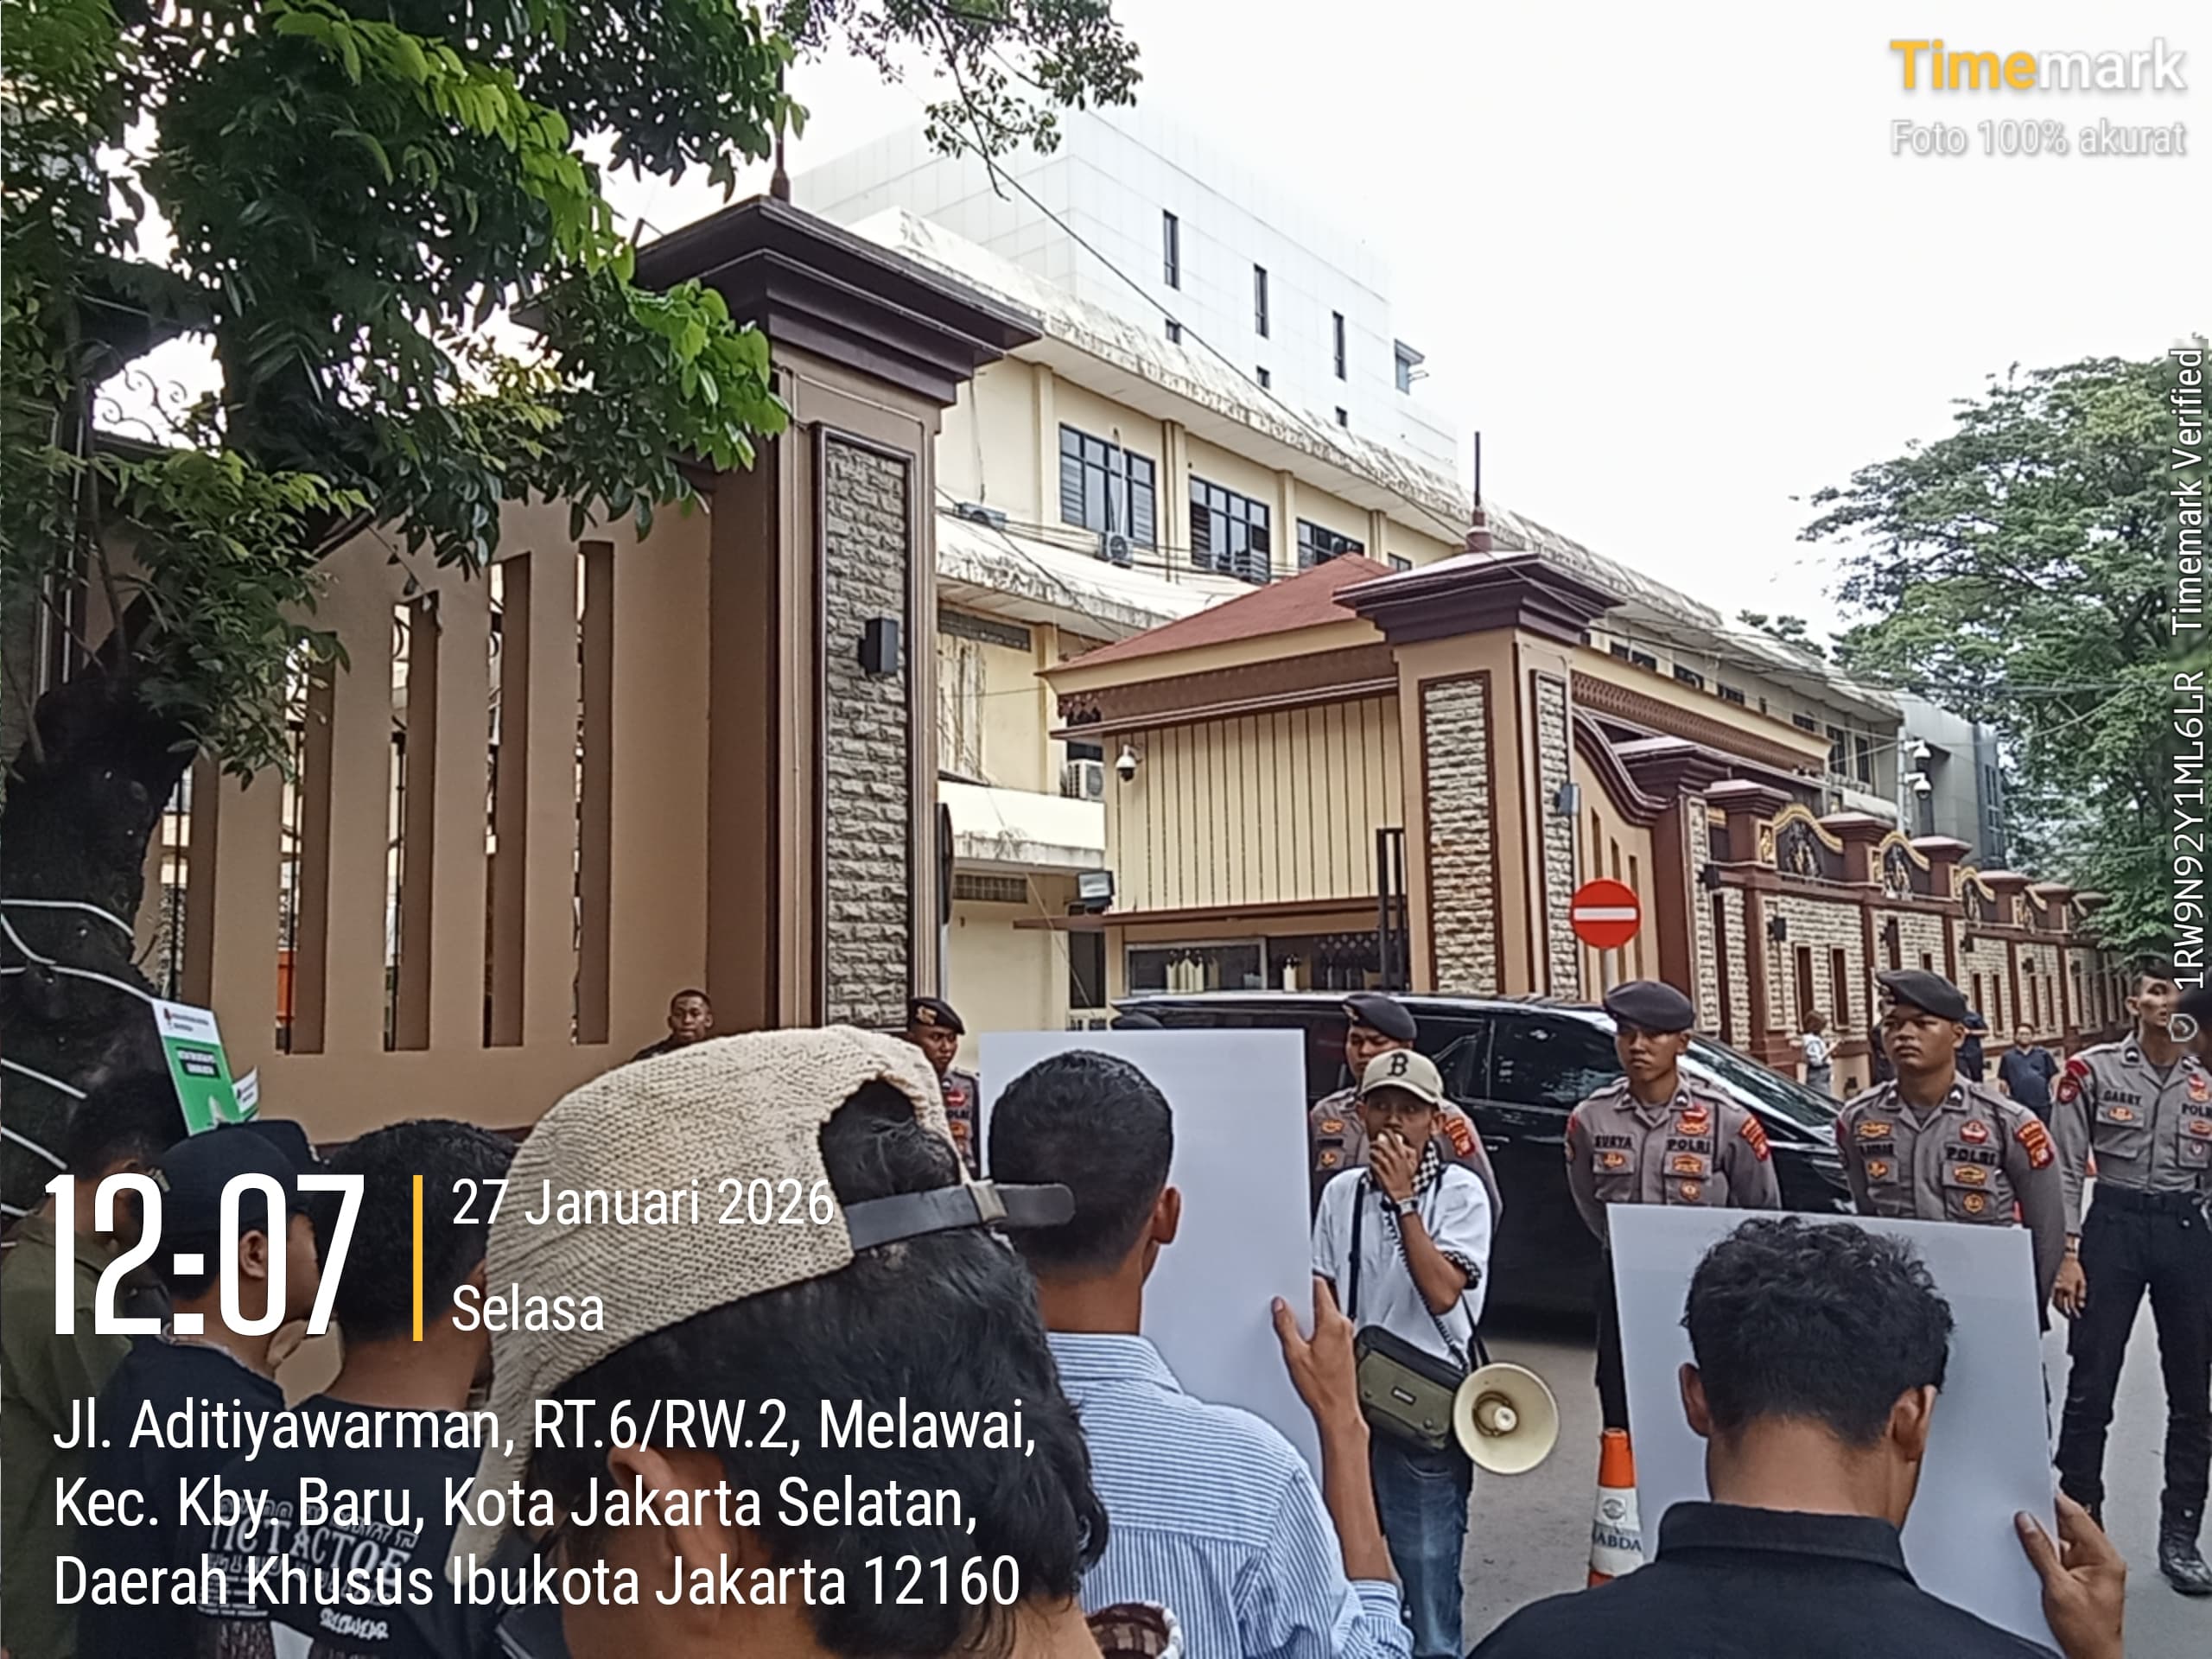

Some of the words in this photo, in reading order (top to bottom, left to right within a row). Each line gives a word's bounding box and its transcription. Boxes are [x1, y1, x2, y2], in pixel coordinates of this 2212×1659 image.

[1387, 1052, 1409, 1077] B
[1667, 1138, 1711, 1154] POLRI
[1947, 1147, 1996, 1166] POLRI
